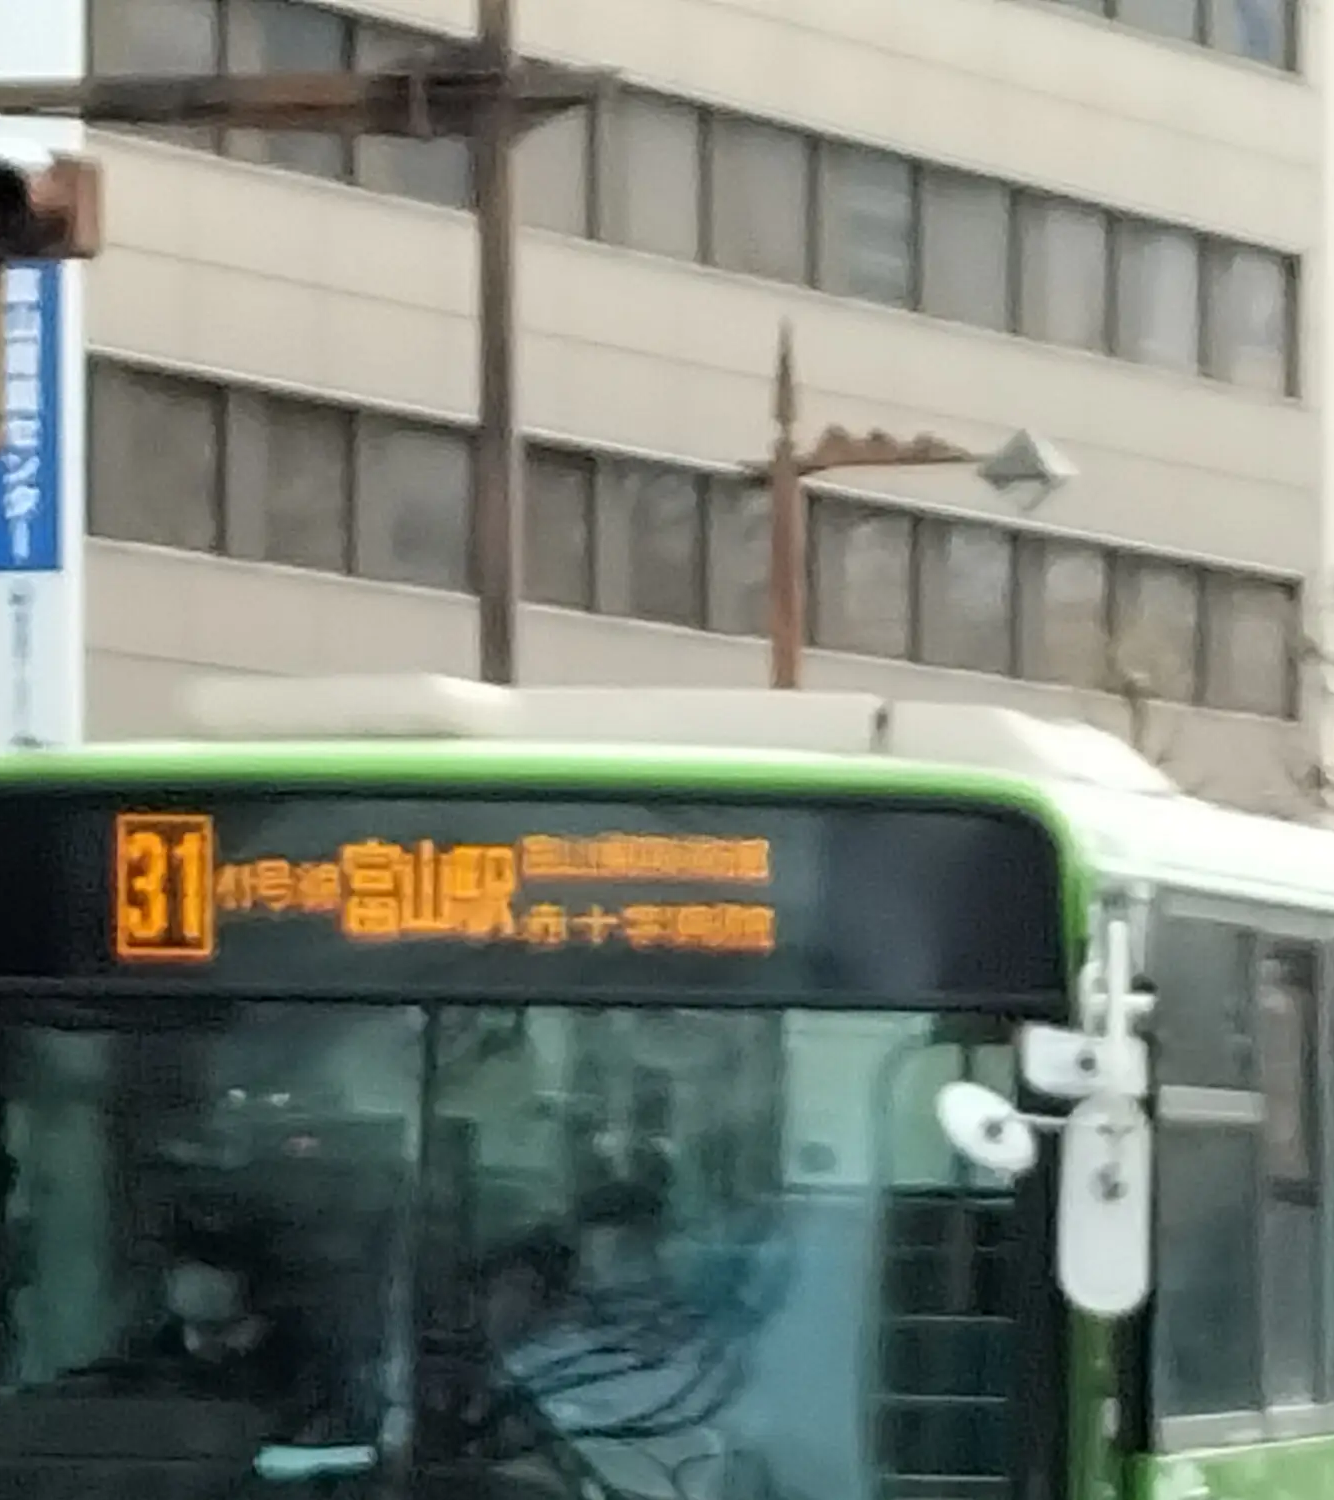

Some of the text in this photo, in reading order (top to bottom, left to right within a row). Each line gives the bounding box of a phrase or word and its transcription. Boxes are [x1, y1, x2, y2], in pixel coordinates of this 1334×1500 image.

[122, 831, 206, 938] 31
[340, 838, 516, 938] 富山駅
